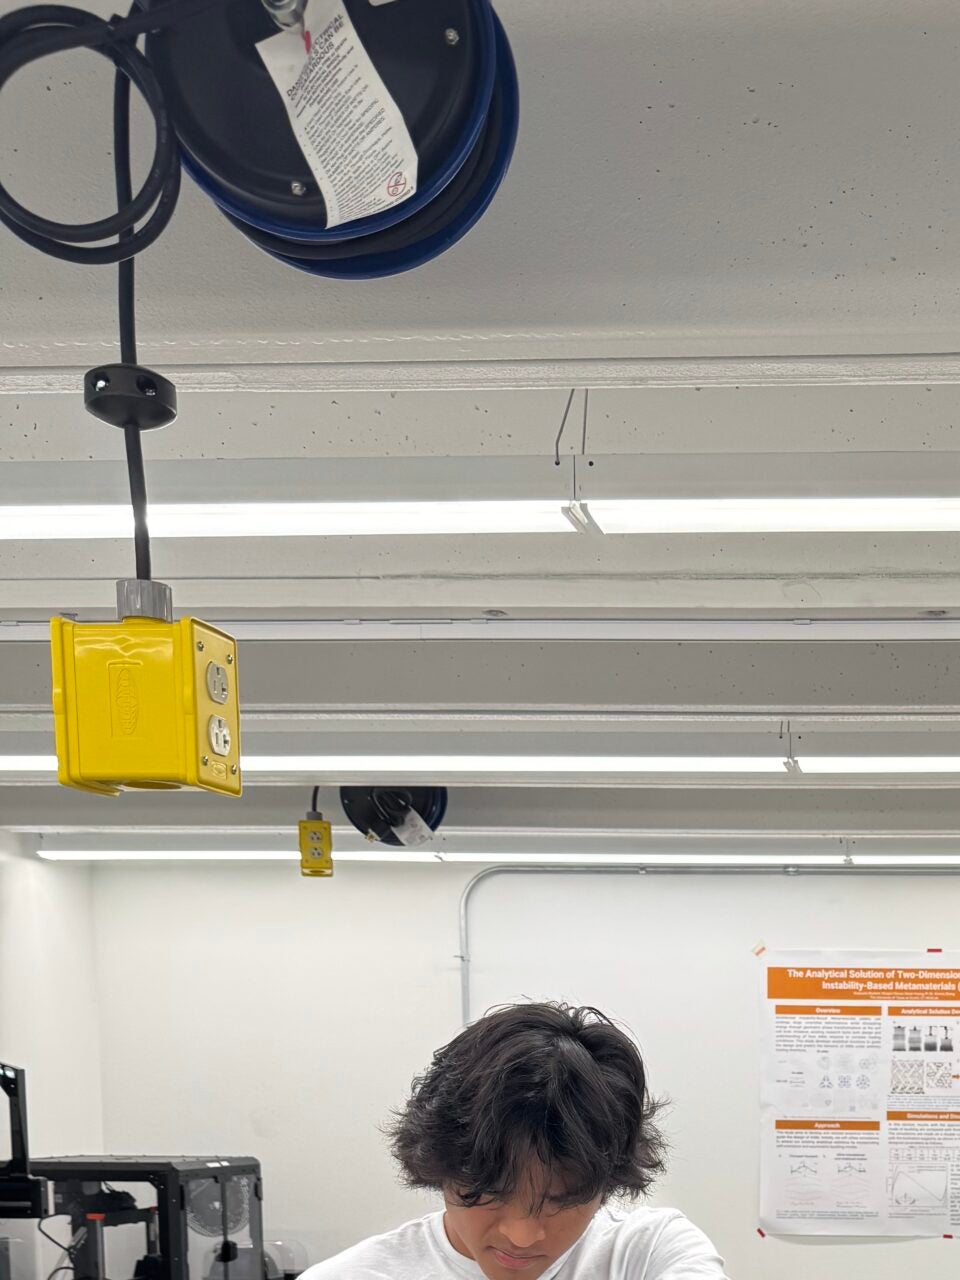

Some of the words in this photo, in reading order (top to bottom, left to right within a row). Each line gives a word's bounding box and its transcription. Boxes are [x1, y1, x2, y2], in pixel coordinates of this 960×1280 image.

[787, 969, 804, 978] The
[805, 969, 847, 980] Analytical
[849, 970, 884, 979] Solution
[886, 970, 895, 979] of
[822, 980, 894, 991] Instability-Based
[895, 981, 956, 991] Metamaterials
